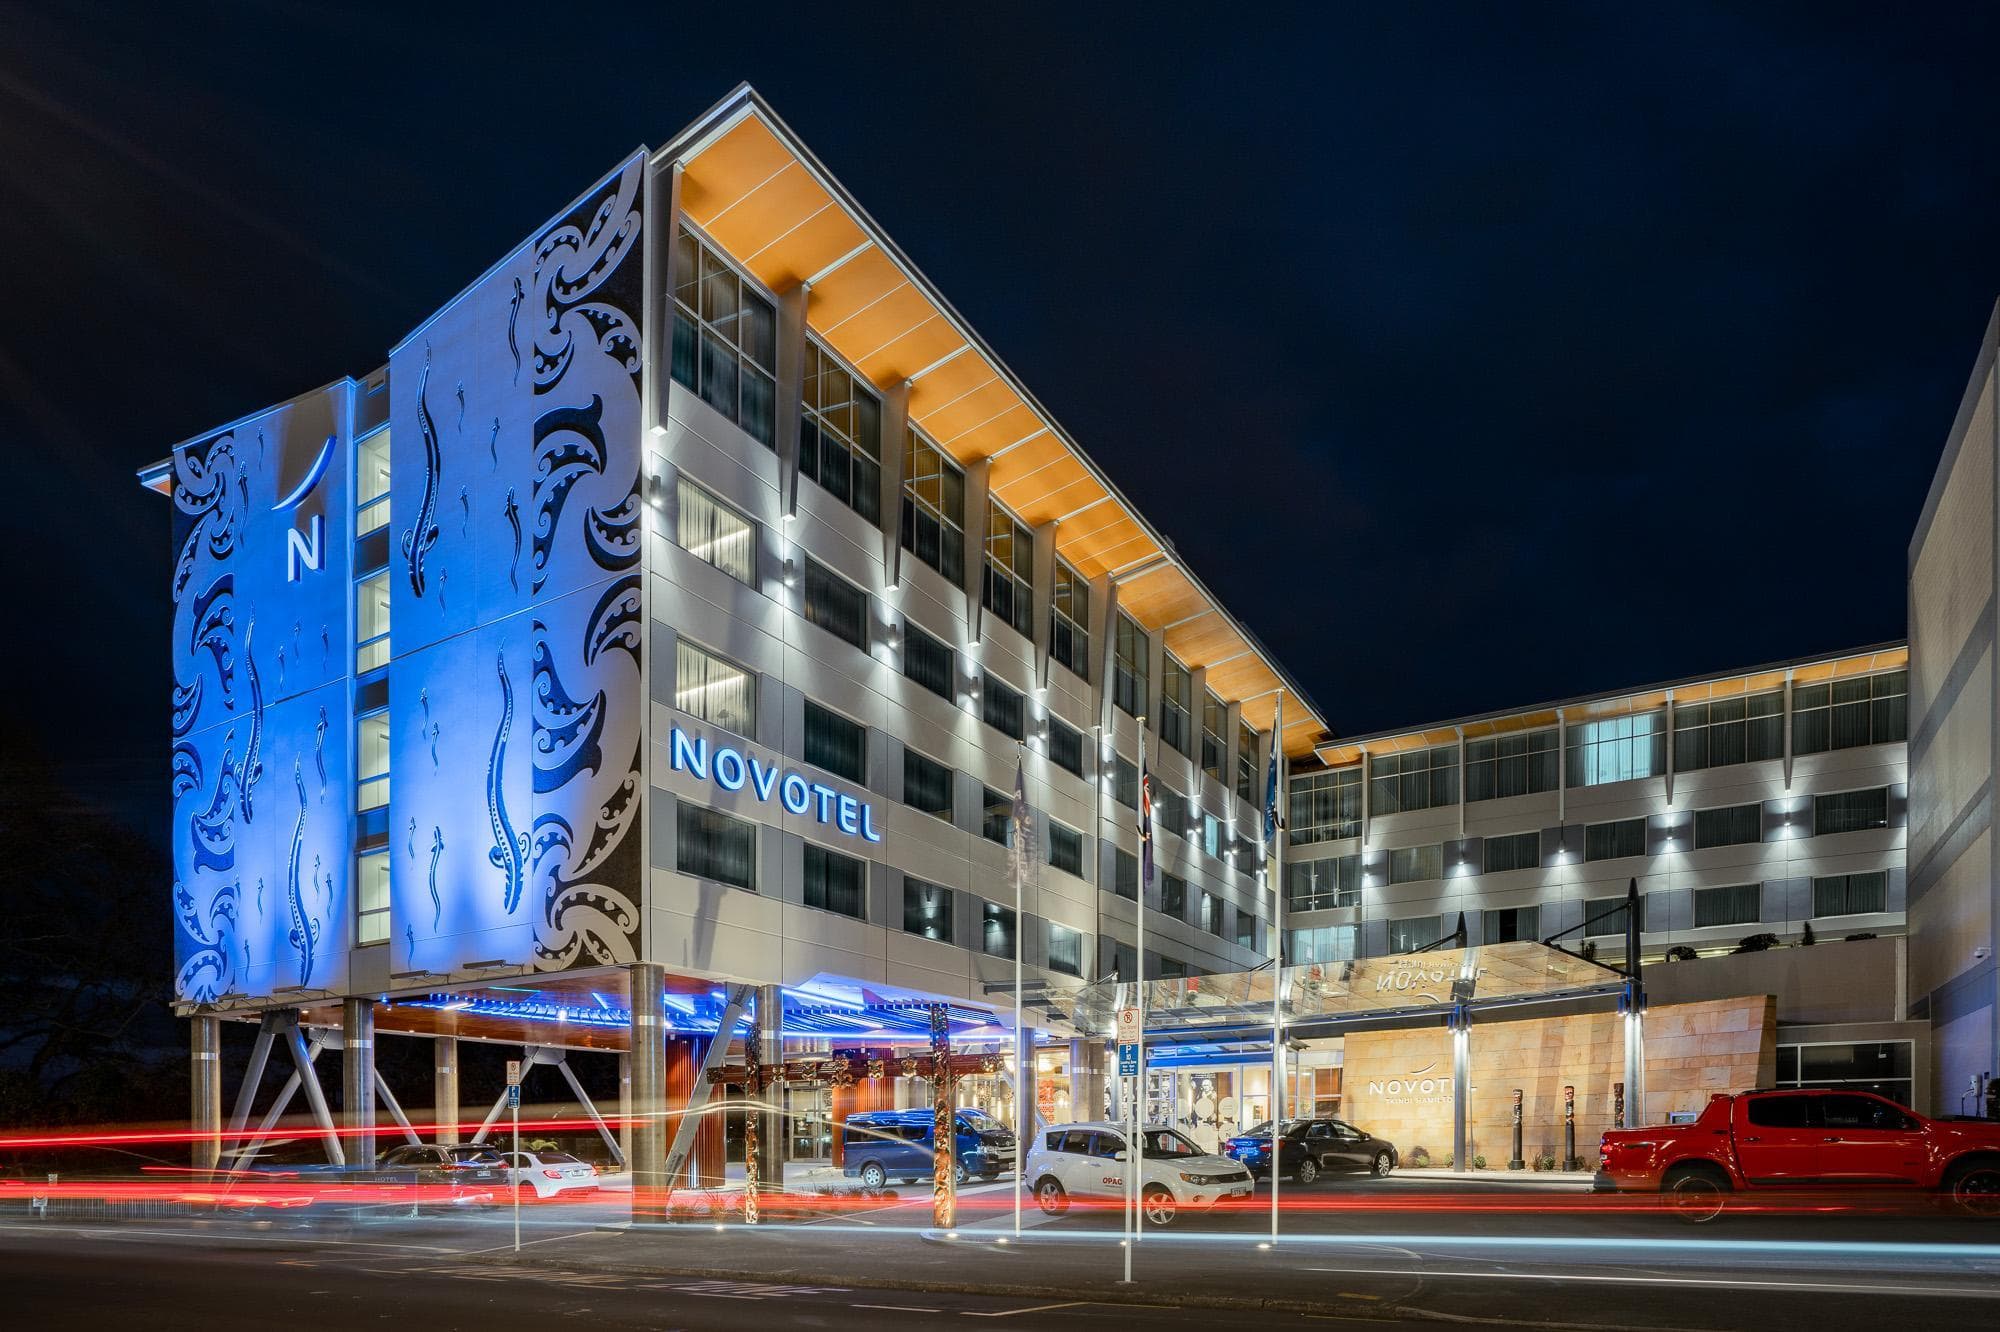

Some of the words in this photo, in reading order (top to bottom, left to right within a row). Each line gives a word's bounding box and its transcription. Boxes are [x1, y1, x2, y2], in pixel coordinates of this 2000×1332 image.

[287, 514, 326, 583] N
[670, 727, 881, 842] NOVOTEL
[1102, 1176, 1123, 1185] OPAC
